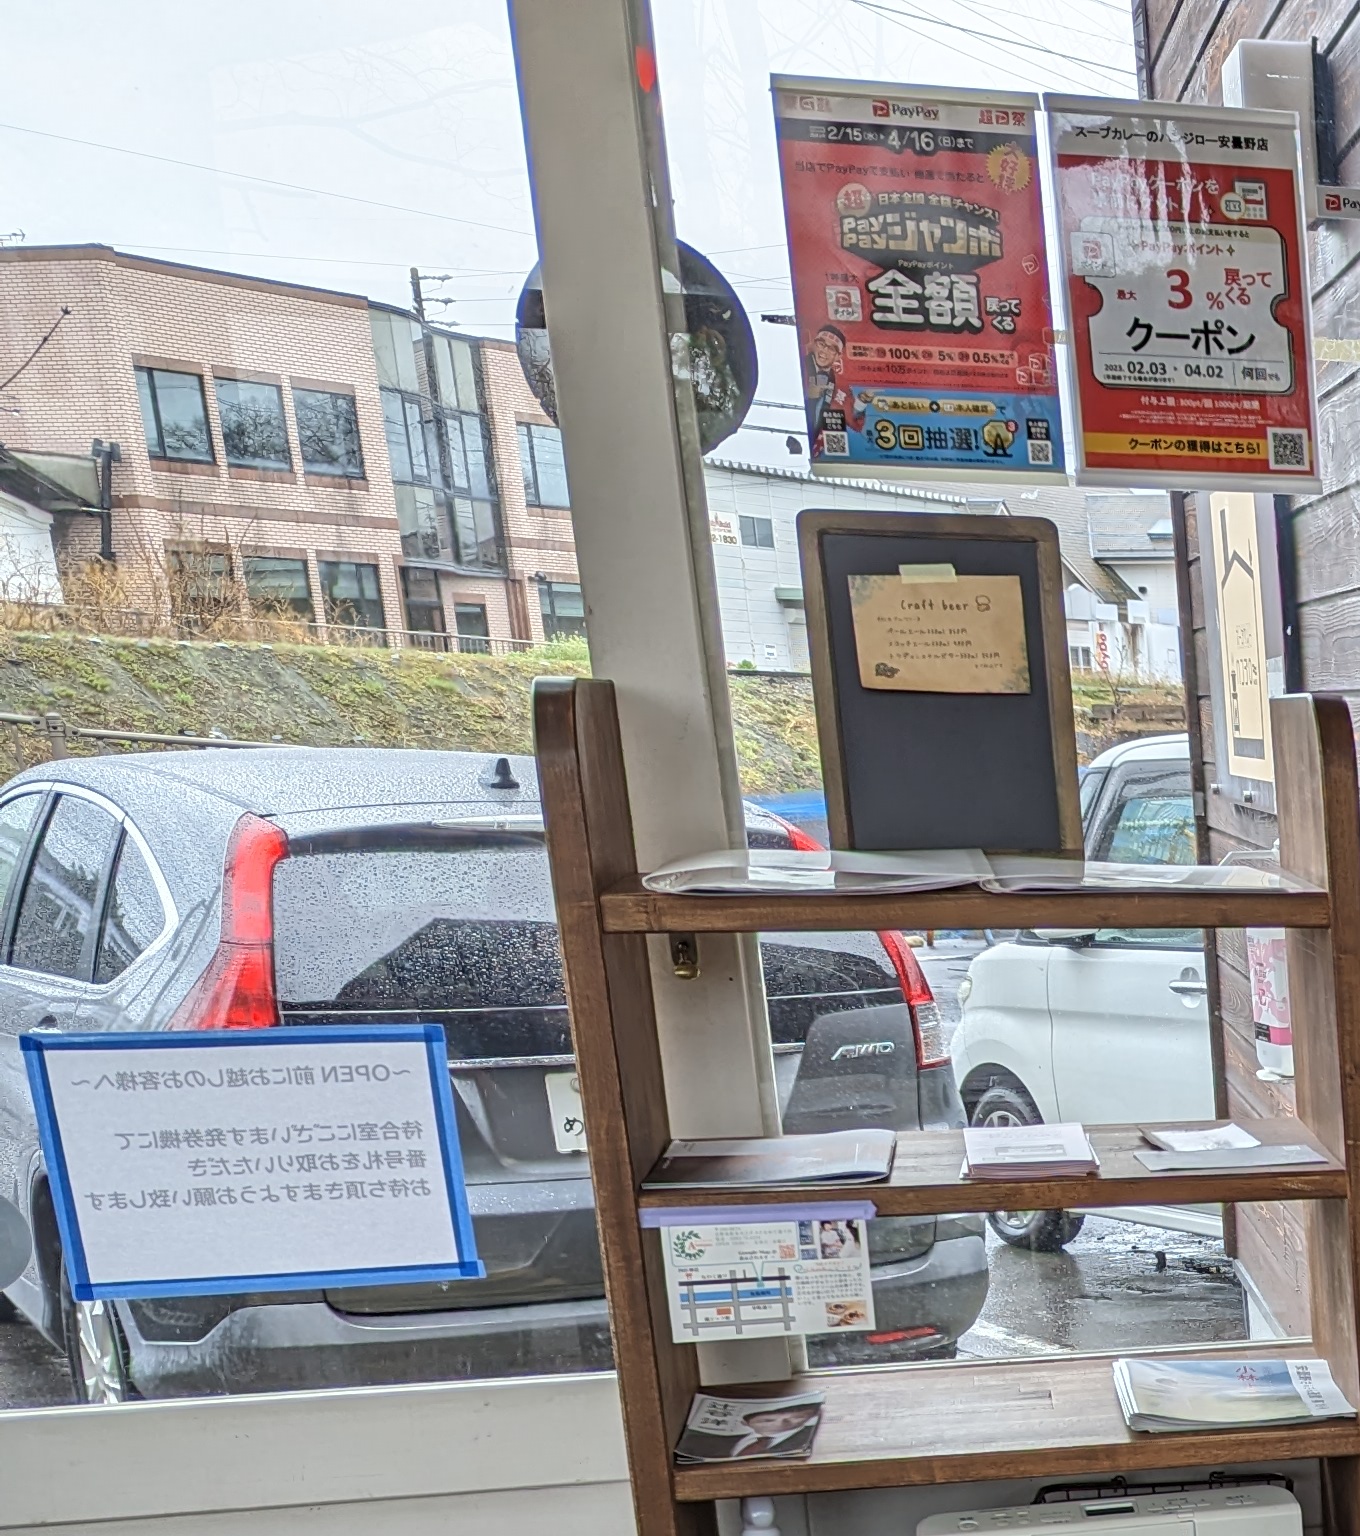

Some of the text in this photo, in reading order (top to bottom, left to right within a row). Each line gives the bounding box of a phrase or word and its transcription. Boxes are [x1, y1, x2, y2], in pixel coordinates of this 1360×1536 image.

[892, 103, 940, 120] PayPay
[842, 215, 885, 233] Pay
[842, 232, 886, 249] Pay
[1223, 267, 1272, 288] 戻って
[1116, 288, 1137, 301] 最大
[1166, 268, 1194, 310] 3
[1224, 287, 1252, 306] くる
[867, 269, 983, 328] 全額
[1126, 316, 1256, 356] クーポン
[1127, 361, 1167, 376] 02.03
[1184, 363, 1225, 379] 04.02
[900, 598, 970, 611] Craft beer
[563, 1116, 584, 1137] め
